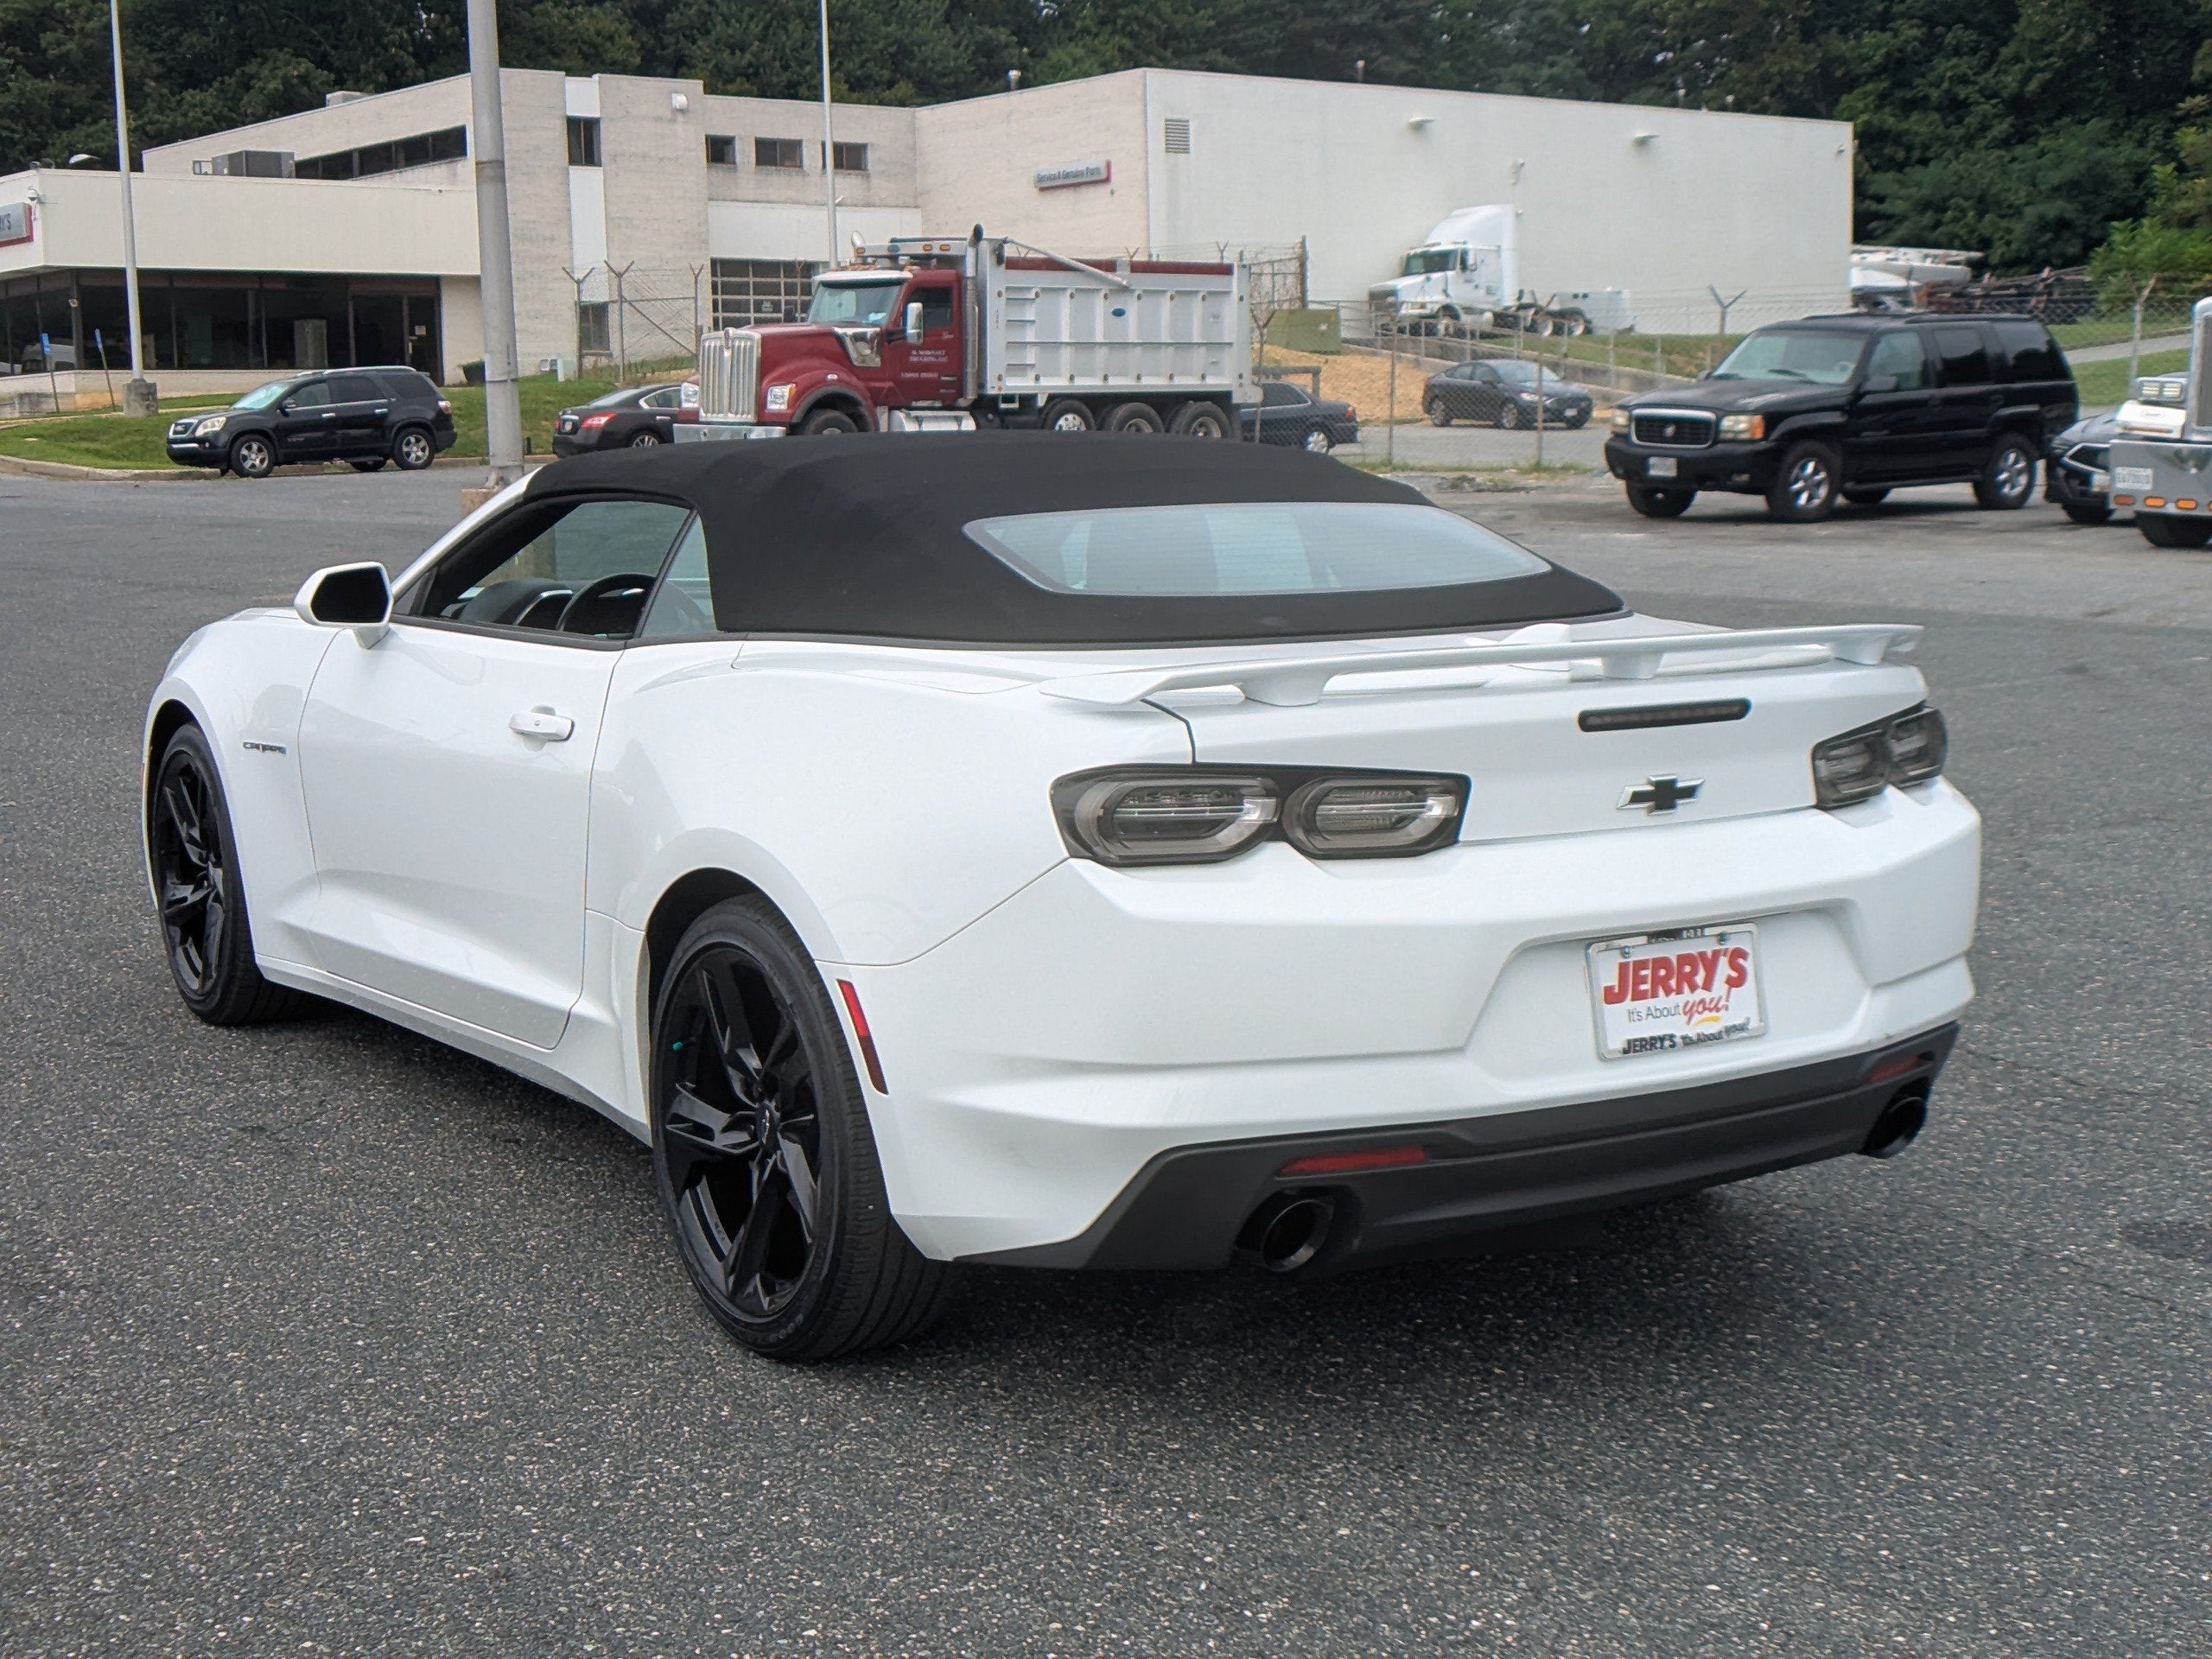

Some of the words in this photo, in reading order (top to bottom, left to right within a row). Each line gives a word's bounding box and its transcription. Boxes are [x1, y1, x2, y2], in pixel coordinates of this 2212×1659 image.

[1604, 947, 1750, 1005] JERRY'S
[1628, 1007, 1643, 1022] It's
[1644, 1002, 1681, 1020] About
[1622, 1033, 1678, 1055] JERRY'S
